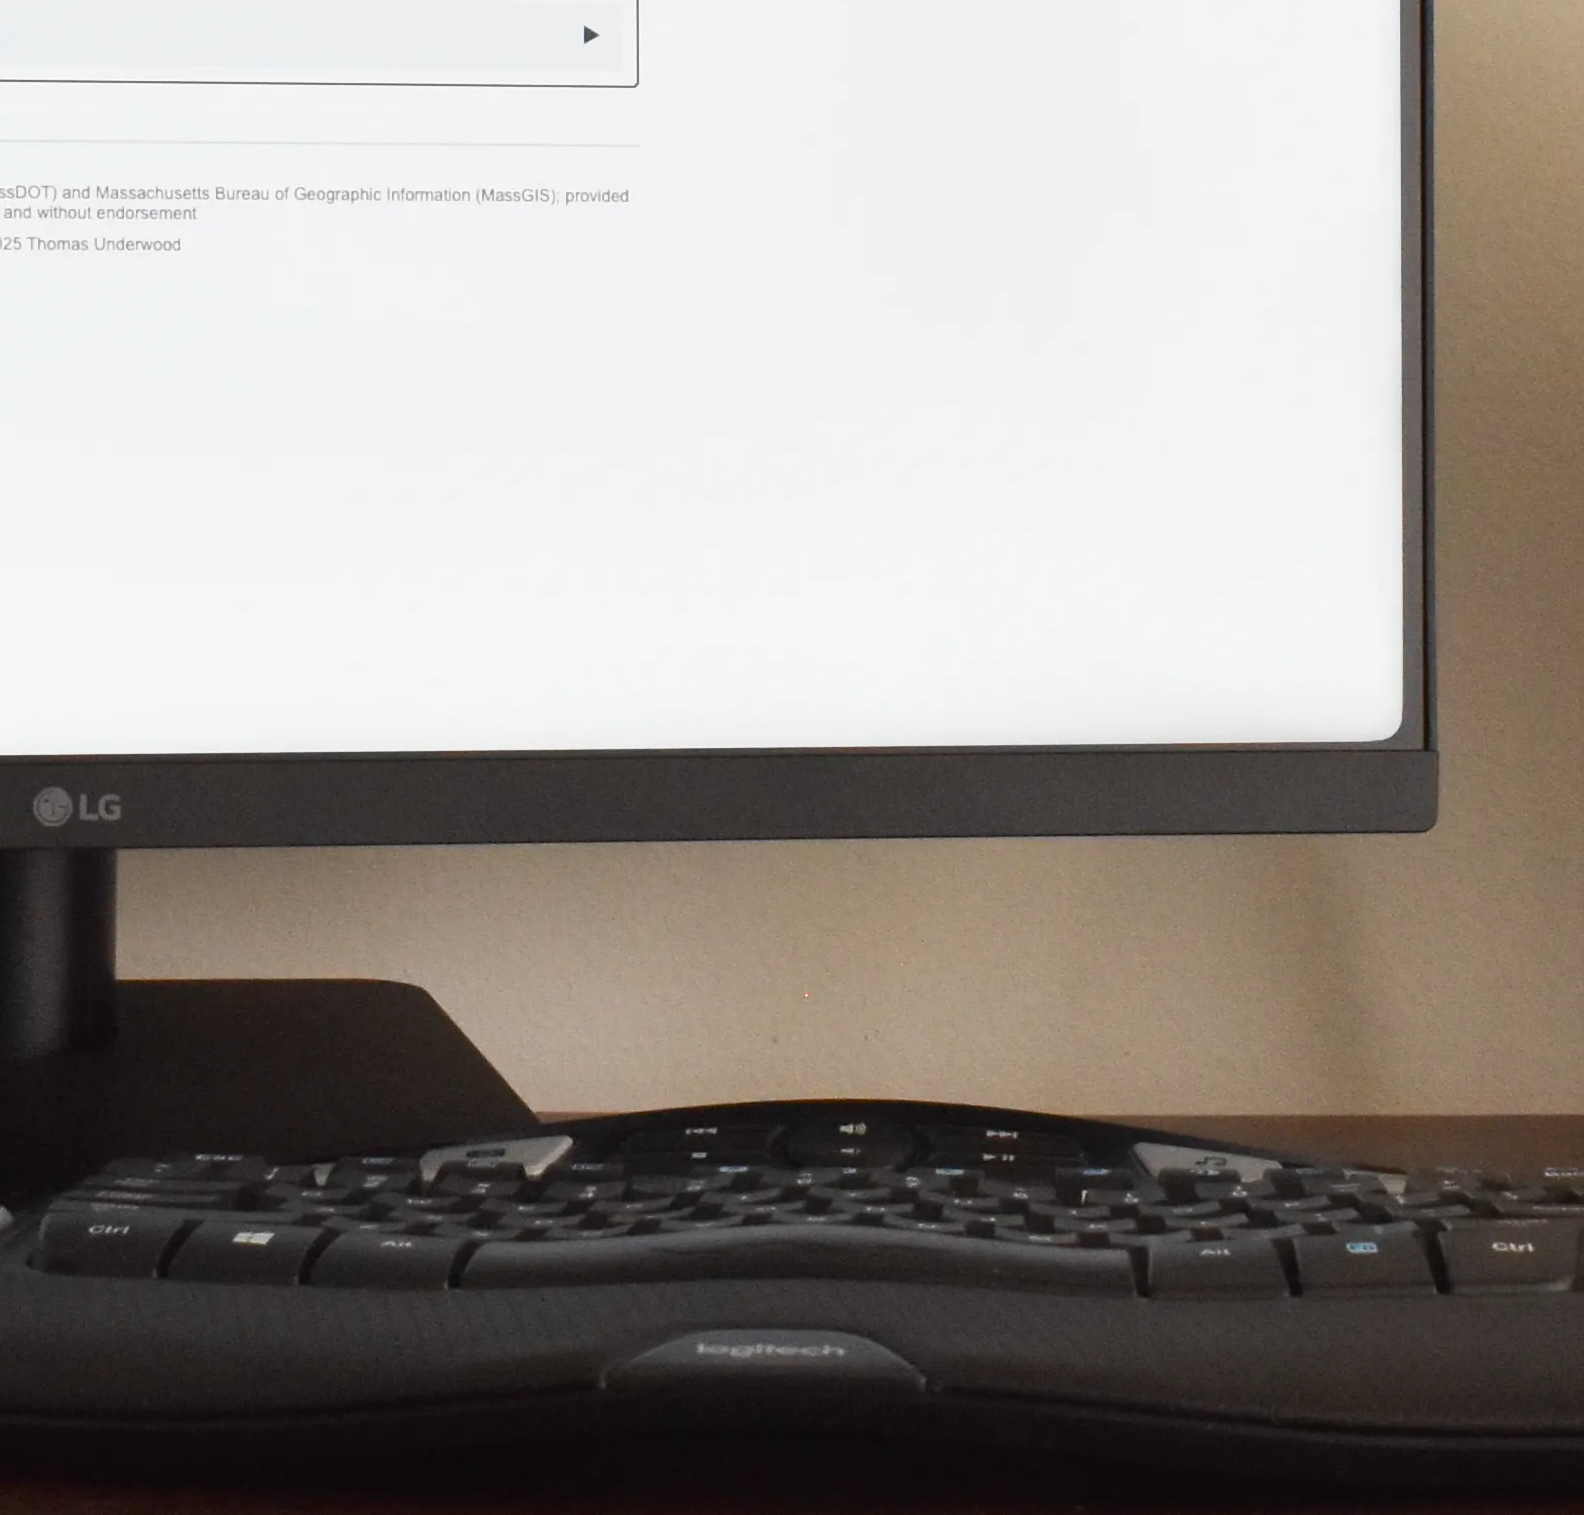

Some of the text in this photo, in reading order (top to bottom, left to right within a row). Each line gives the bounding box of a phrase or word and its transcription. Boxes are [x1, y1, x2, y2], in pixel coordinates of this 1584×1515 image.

[61, 186, 91, 200] and
[95, 185, 210, 201] Massachusetts
[214, 186, 270, 201] Bureau
[274, 186, 290, 201] of
[293, 186, 382, 205] Geographic
[386, 187, 471, 202] Information
[475, 188, 560, 206] (MassGIS);
[565, 189, 630, 206] provided
[3, 206, 32, 220] and
[36, 204, 93, 221] without
[96, 206, 197, 220] endorsement
[26, 236, 89, 251] Thomas
[93, 237, 182, 252] Underwood
[79, 793, 122, 821] LG
[88, 1225, 130, 1235] Ctrl
[1491, 1242, 1536, 1253] Ctrl
[696, 1342, 847, 1358] logitech
